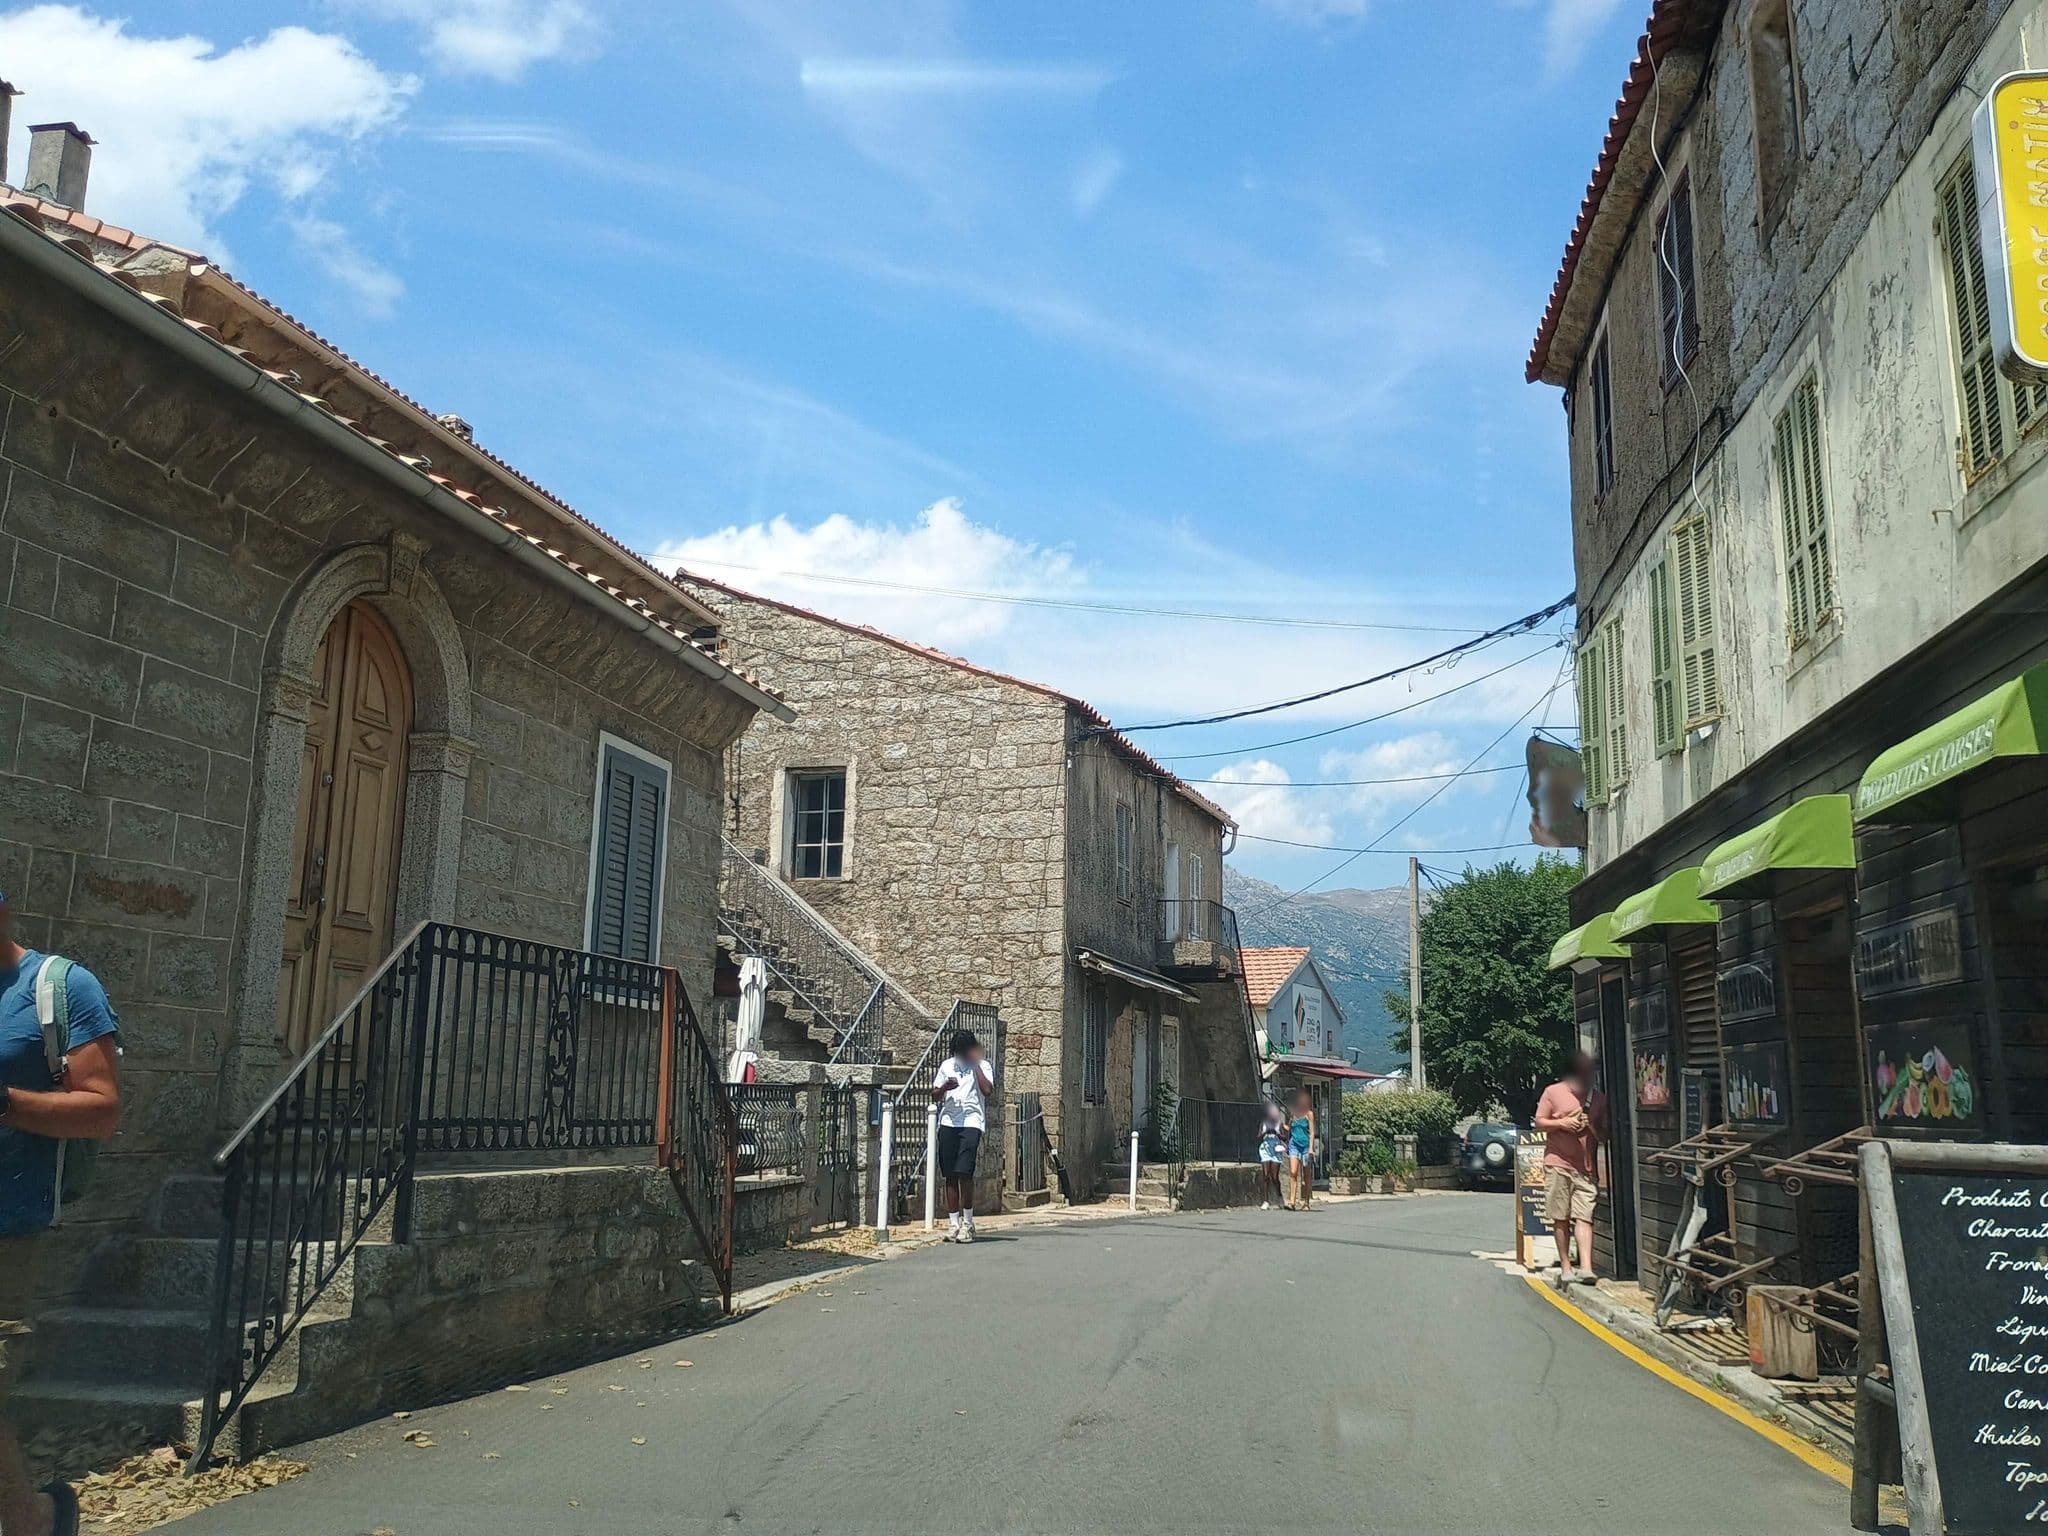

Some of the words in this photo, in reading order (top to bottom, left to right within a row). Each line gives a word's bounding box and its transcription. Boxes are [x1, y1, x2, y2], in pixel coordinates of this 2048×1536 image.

[1860, 754, 1931, 811] PRODUITS
[1930, 718, 1996, 777] CORSES
[2004, 1389, 2048, 1411] Can
[1973, 1424, 2042, 1447] Huiles
